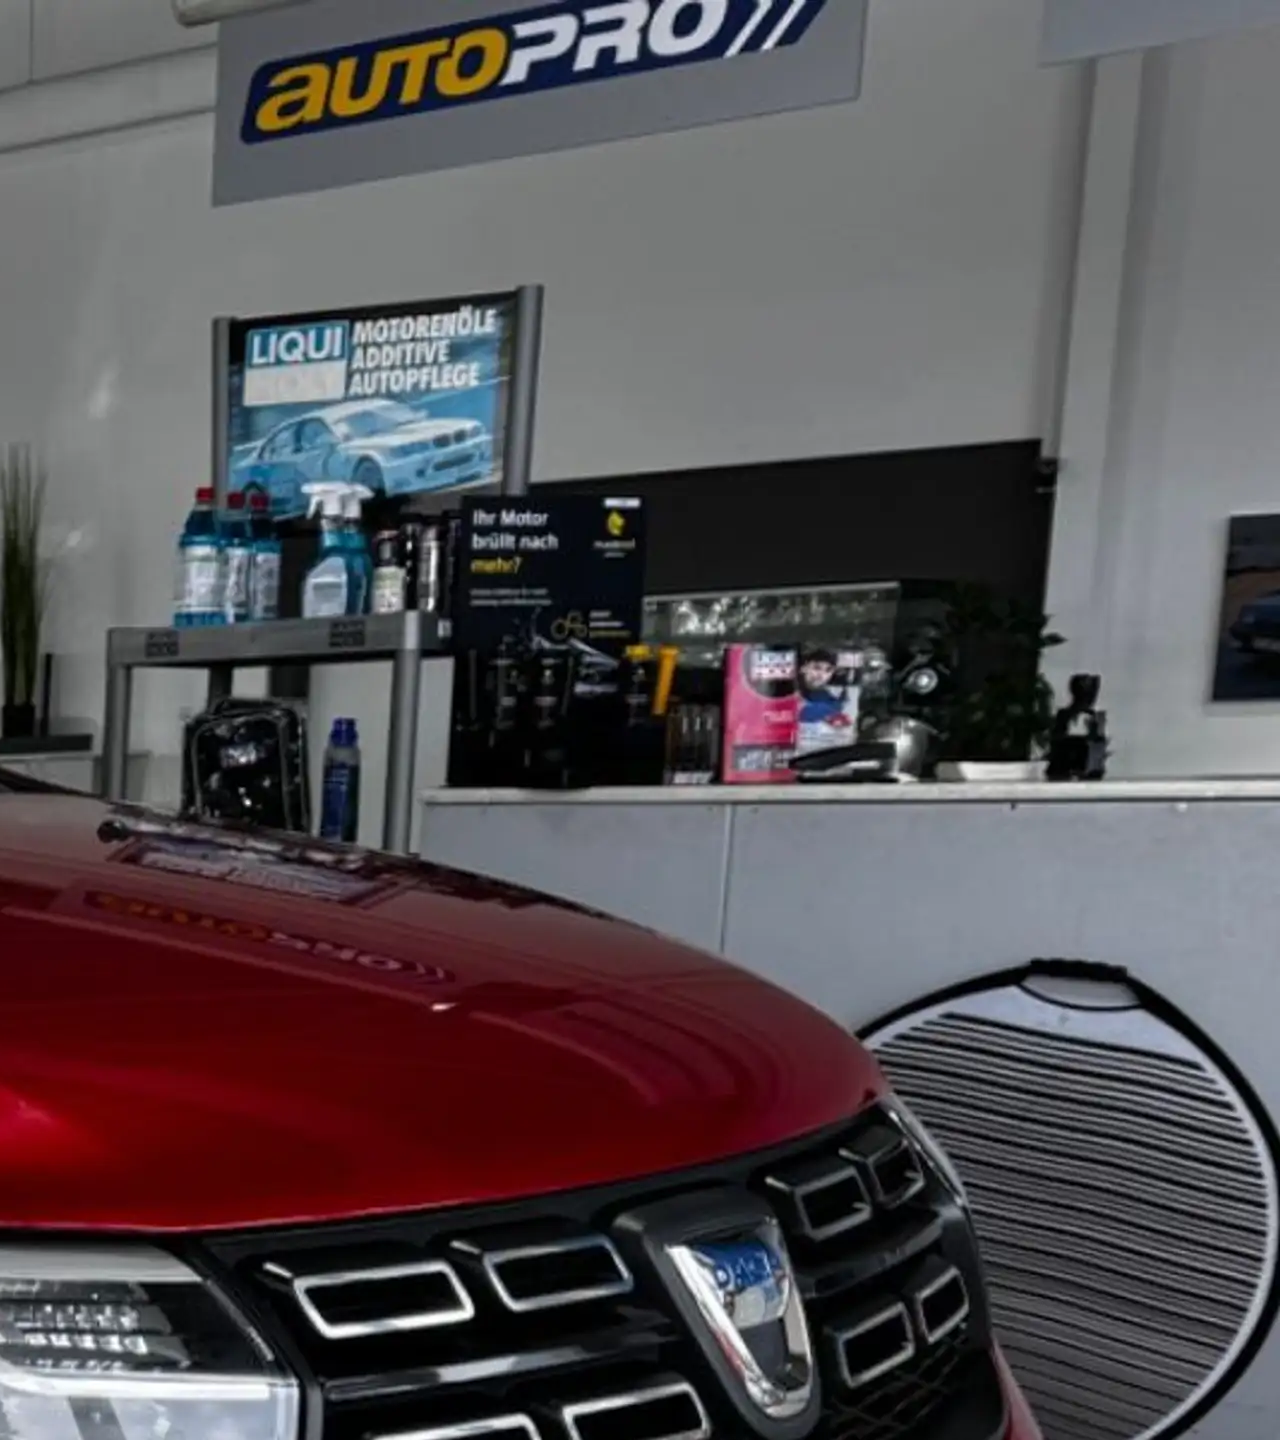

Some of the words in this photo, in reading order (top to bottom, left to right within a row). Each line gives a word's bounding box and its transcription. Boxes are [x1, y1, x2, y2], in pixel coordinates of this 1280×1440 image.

[352, 305, 497, 344] MOTORENÖLE
[251, 326, 344, 364] LIQUI
[351, 339, 452, 369] ADDITIVE
[348, 361, 481, 396] AUTOPFLEGE
[472, 509, 497, 526] Ihr
[499, 509, 549, 527] Motor
[472, 532, 516, 550] brüllt
[519, 532, 559, 550] nach
